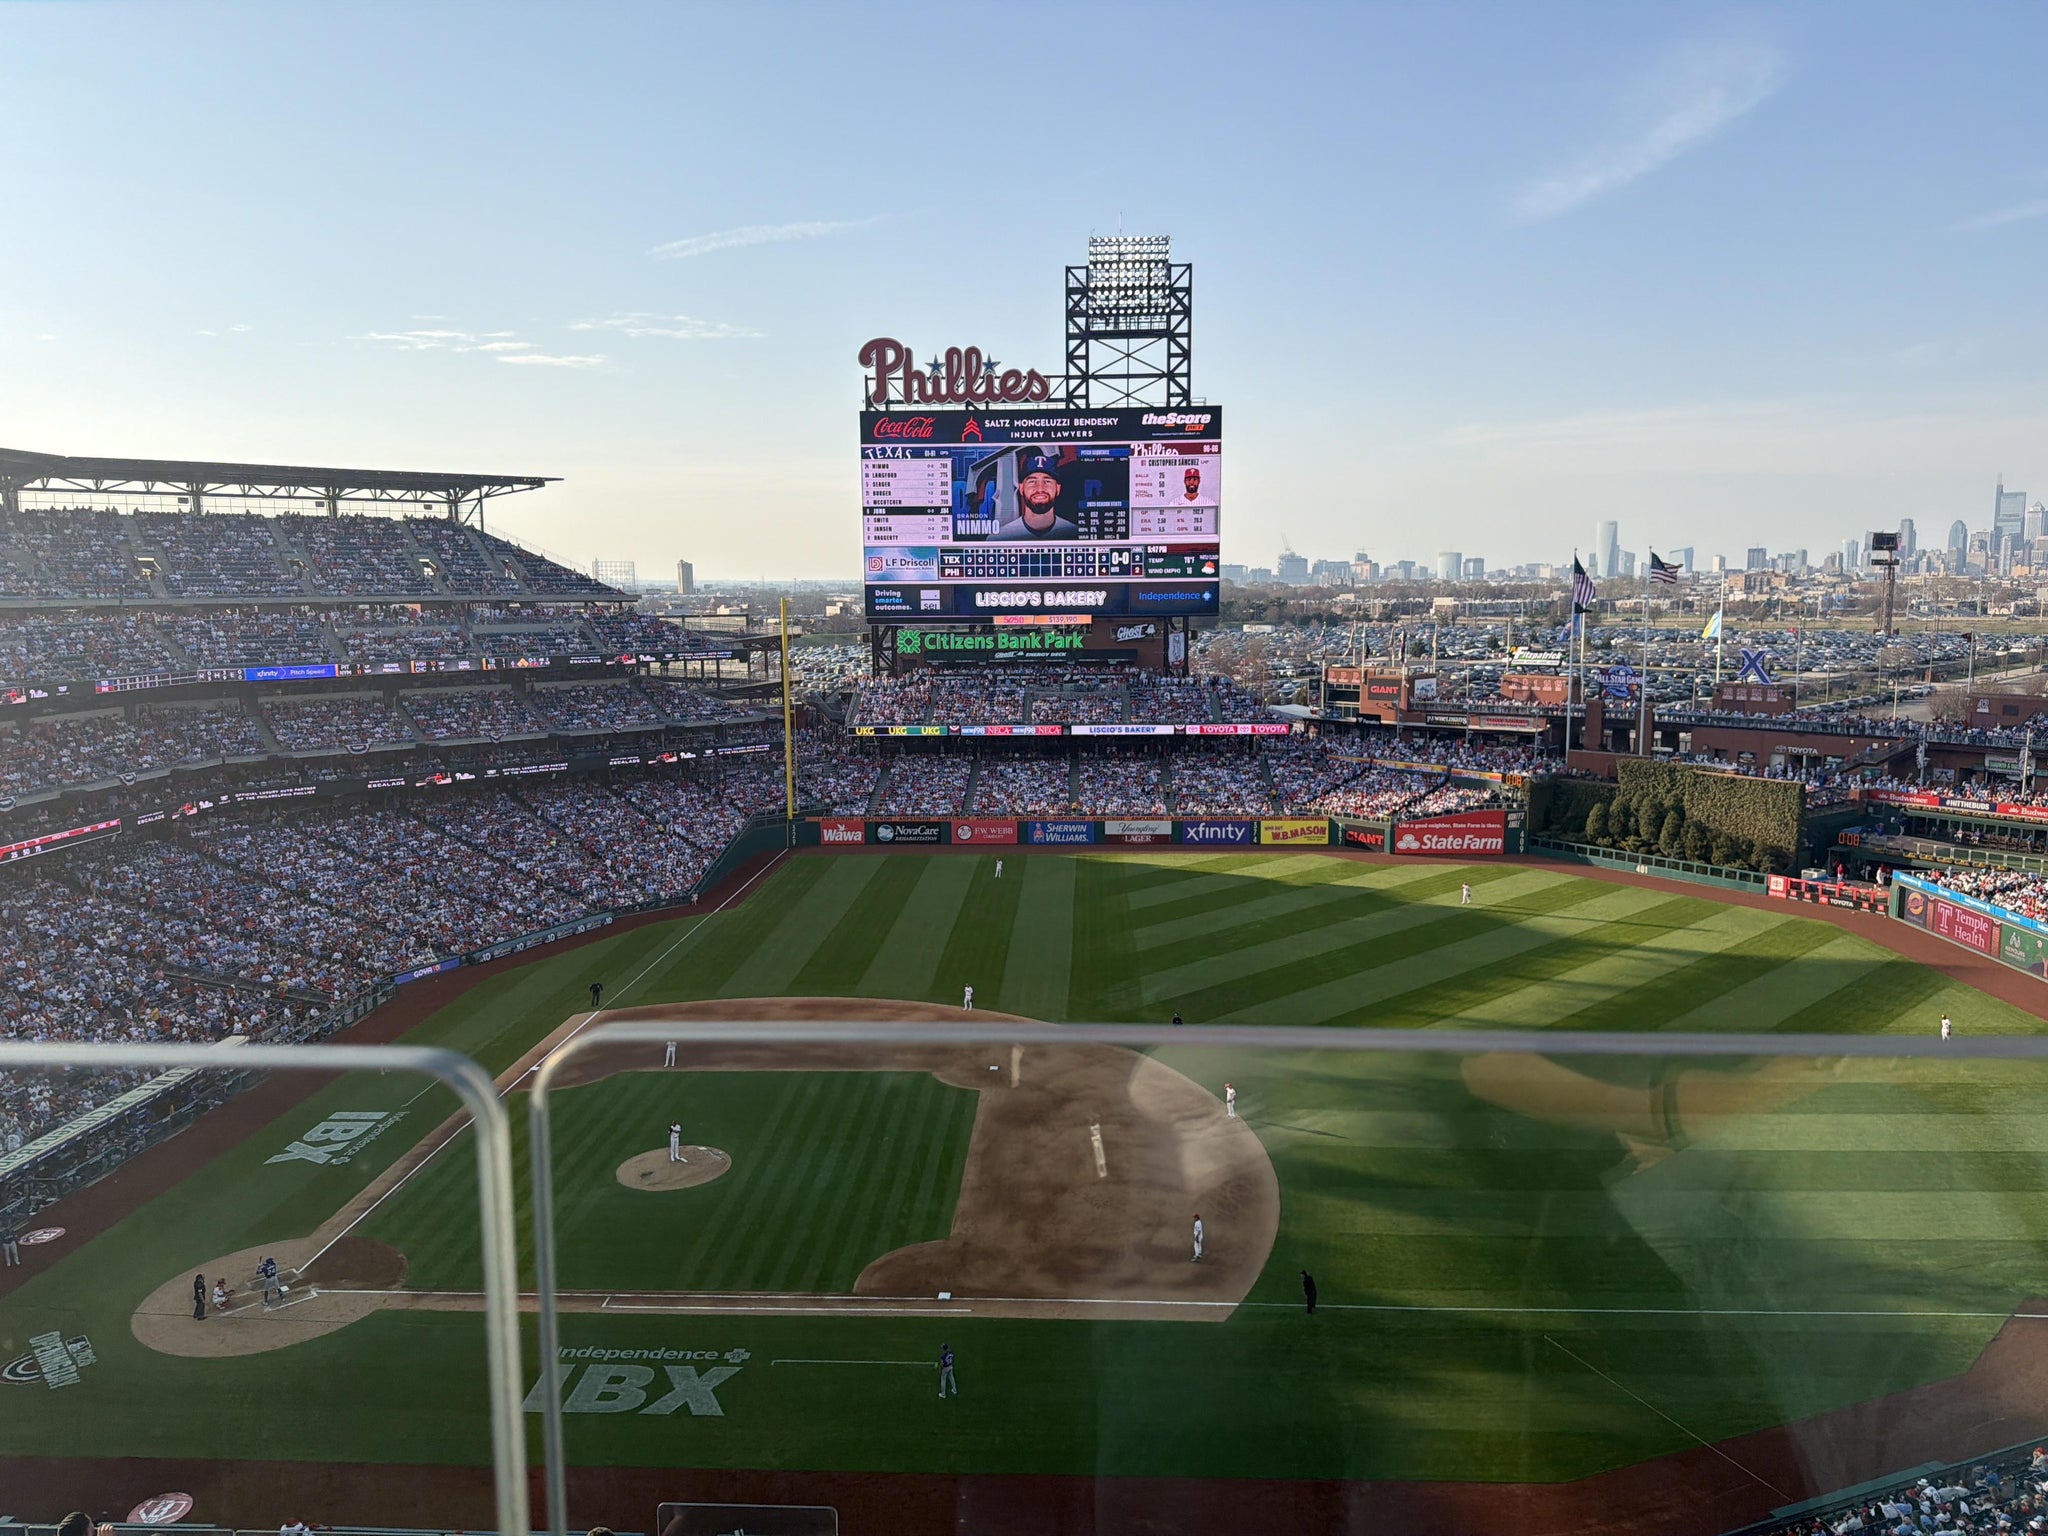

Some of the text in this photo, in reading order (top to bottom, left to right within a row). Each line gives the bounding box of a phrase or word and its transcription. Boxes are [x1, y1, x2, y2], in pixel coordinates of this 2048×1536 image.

[858, 337, 1049, 405] Phillies
[1014, 418, 1070, 427] MONGELUZZI
[1074, 417, 1118, 426] BENDESKY
[1142, 413, 1211, 425] theScore
[865, 447, 912, 460] TEXAS
[1130, 444, 1180, 456] Phillies
[957, 520, 999, 534] NIMMO
[900, 558, 934, 566] Driscoll
[1112, 552, 1129, 564] 0-0
[976, 591, 1106, 607] LISCIO'S BAKERY
[1139, 592, 1200, 601] Independence
[1116, 625, 1146, 641] GHOST
[924, 632, 1083, 650] Citizens Bank Park
[1514, 647, 1562, 659] Fitzpatrick
[306, 668, 325, 677] Speed
[1610, 675, 1626, 683] STAR
[1627, 675, 1644, 684] GAME
[1788, 746, 1818, 755] TOYOTA
[1890, 793, 1928, 804] Budweiser
[1946, 800, 1989, 810] #HITTHEBUDS
[137, 814, 164, 825] ESCALADE
[895, 825, 939, 835] NovaCare
[1046, 823, 1086, 832] SHERWIN
[1118, 823, 1160, 833] Yuengling
[1187, 823, 1246, 841] xfinity
[823, 829, 862, 841] Wawa
[1346, 831, 1384, 844] GIANT
[1636, 865, 1649, 873] 401
[1830, 899, 1853, 907] TOYOTA
[1955, 909, 1988, 932] Temple
[1955, 925, 1985, 948] Health
[414, 967, 432, 978] GOYA
[263, 1112, 390, 1164] IBX
[556, 1346, 719, 1361] Independence
[521, 1363, 742, 1416] IBX
